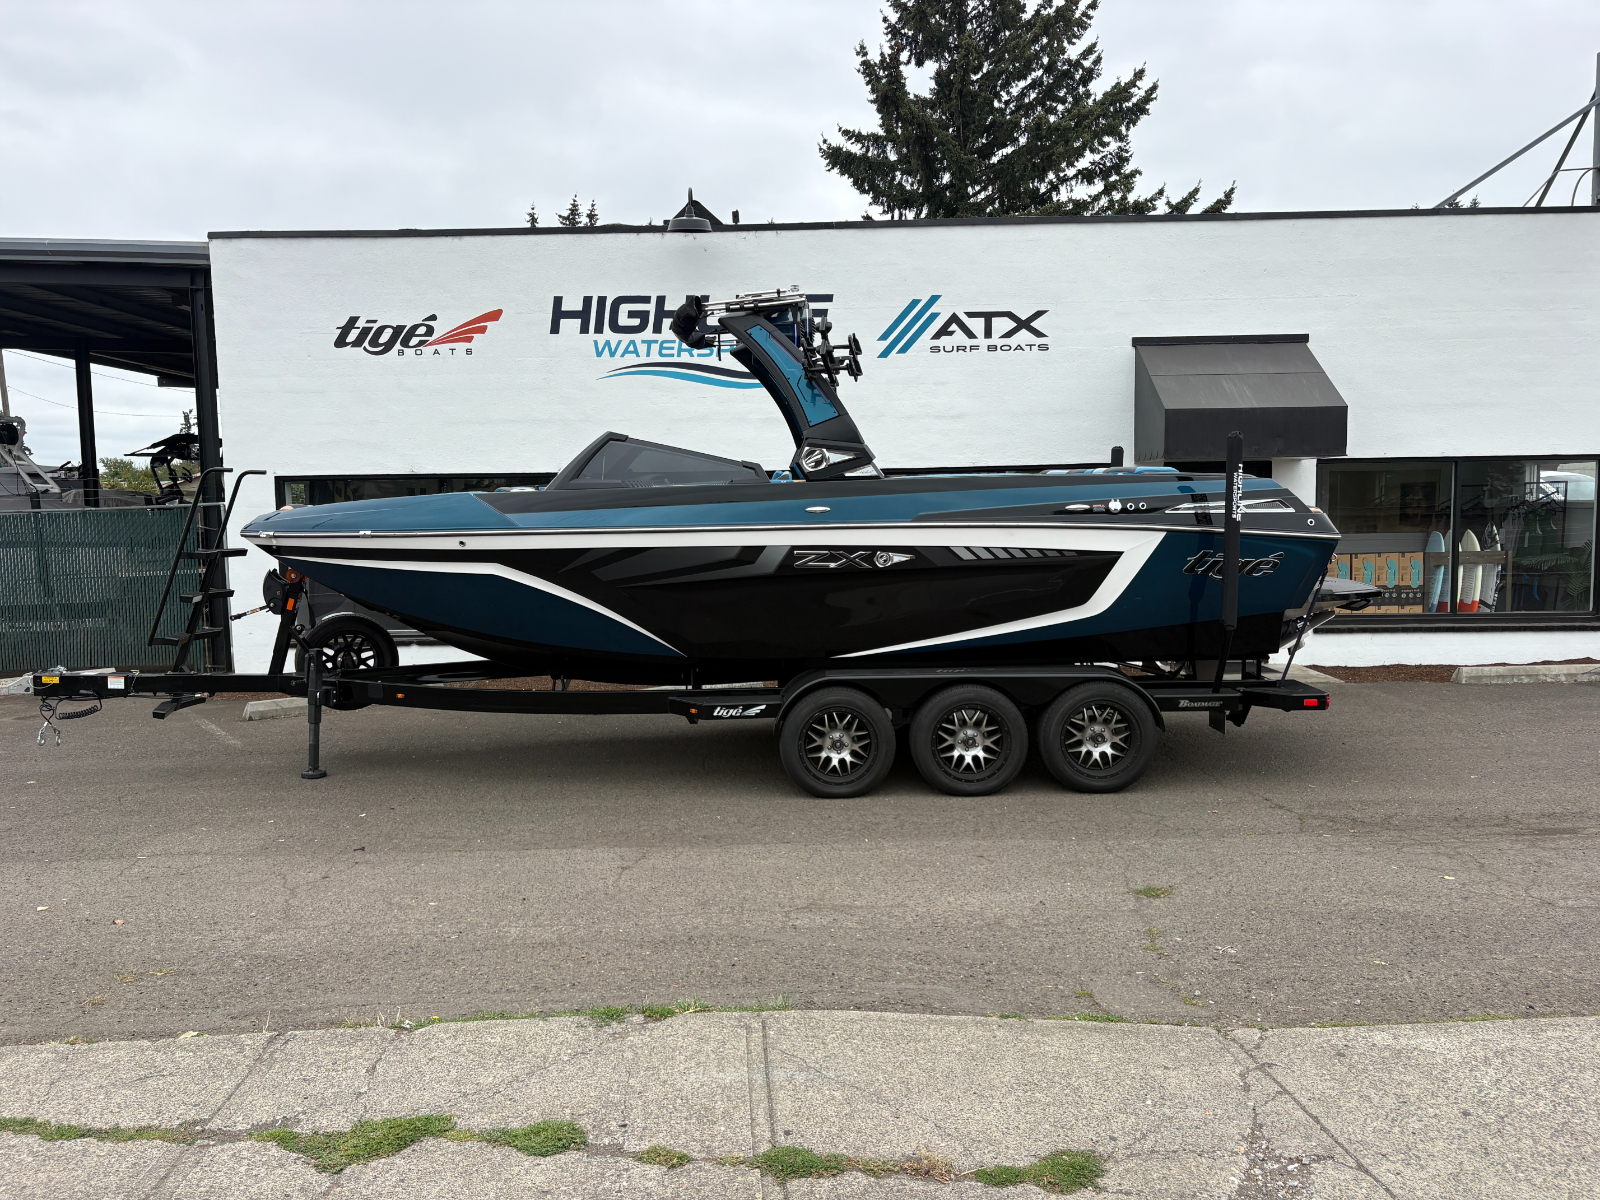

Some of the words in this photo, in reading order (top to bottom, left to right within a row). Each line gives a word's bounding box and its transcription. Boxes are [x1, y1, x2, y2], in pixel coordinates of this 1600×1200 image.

[929, 309, 1050, 340] ATX
[333, 313, 438, 356] tigé
[397, 348, 473, 356] BOATS
[929, 345, 980, 353] SURF
[987, 343, 1050, 352] BOATS
[712, 705, 743, 718] tigé
